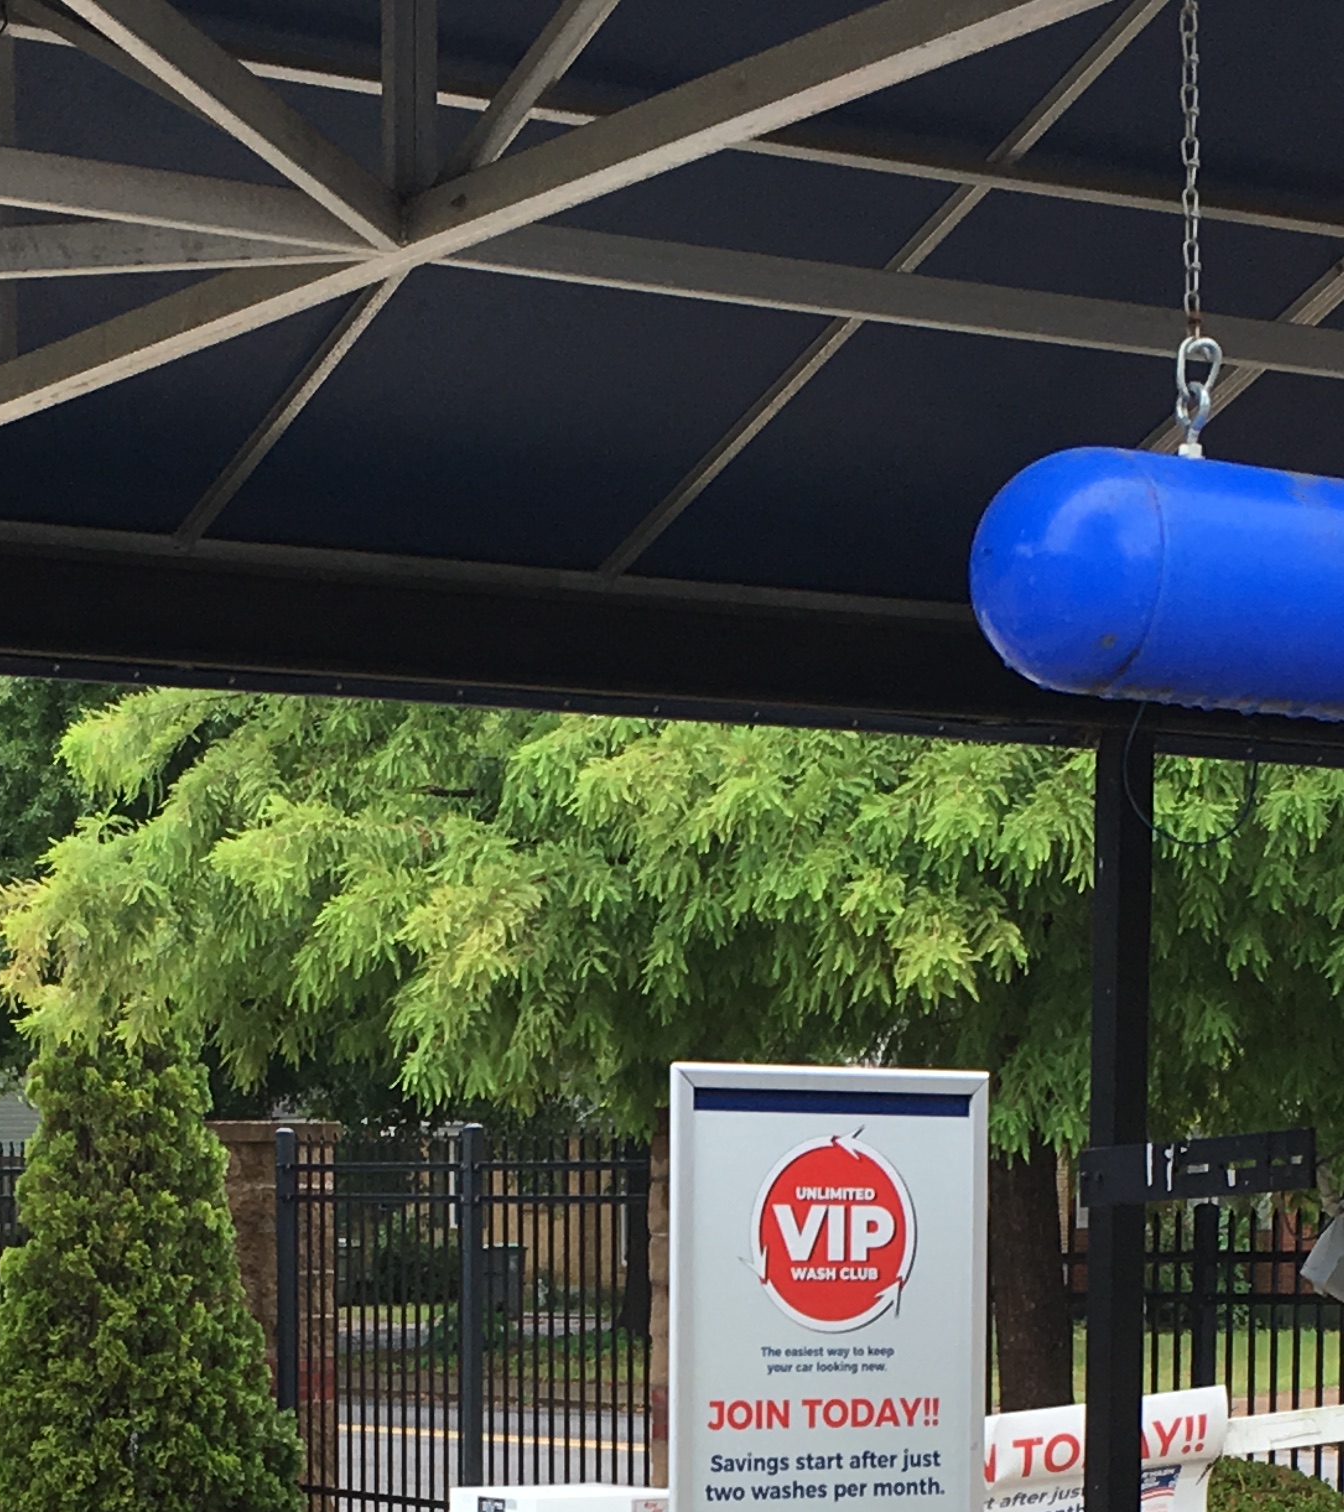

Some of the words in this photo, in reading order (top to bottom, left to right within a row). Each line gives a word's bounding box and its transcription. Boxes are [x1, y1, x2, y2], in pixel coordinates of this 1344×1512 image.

[796, 1187, 876, 1201] UNLIMITED
[771, 1204, 895, 1262] VIP
[791, 1267, 836, 1281] WASH
[839, 1267, 879, 1281] CLUB
[761, 1346, 781, 1357] The
[784, 1346, 824, 1357] easiest
[826, 1347, 850, 1359] way
[853, 1346, 865, 1357] to
[867, 1346, 895, 1359] keep
[767, 1363, 793, 1375] your
[795, 1363, 813, 1373] car
[816, 1361, 858, 1374] looking
[861, 1361, 887, 1372] new.
[707, 1399, 790, 1431] JOIN
[802, 1397, 940, 1429] TODAY!!
[710, 1452, 790, 1476] Savings
[795, 1452, 843, 1471] start
[849, 1450, 898, 1470] after
[901, 1449, 941, 1472] just
[705, 1484, 745, 1501] two
[751, 1480, 827, 1500] washes
[834, 1481, 867, 1502] per
[873, 1477, 945, 1497] month.
[999, 1491, 1048, 1509] after
